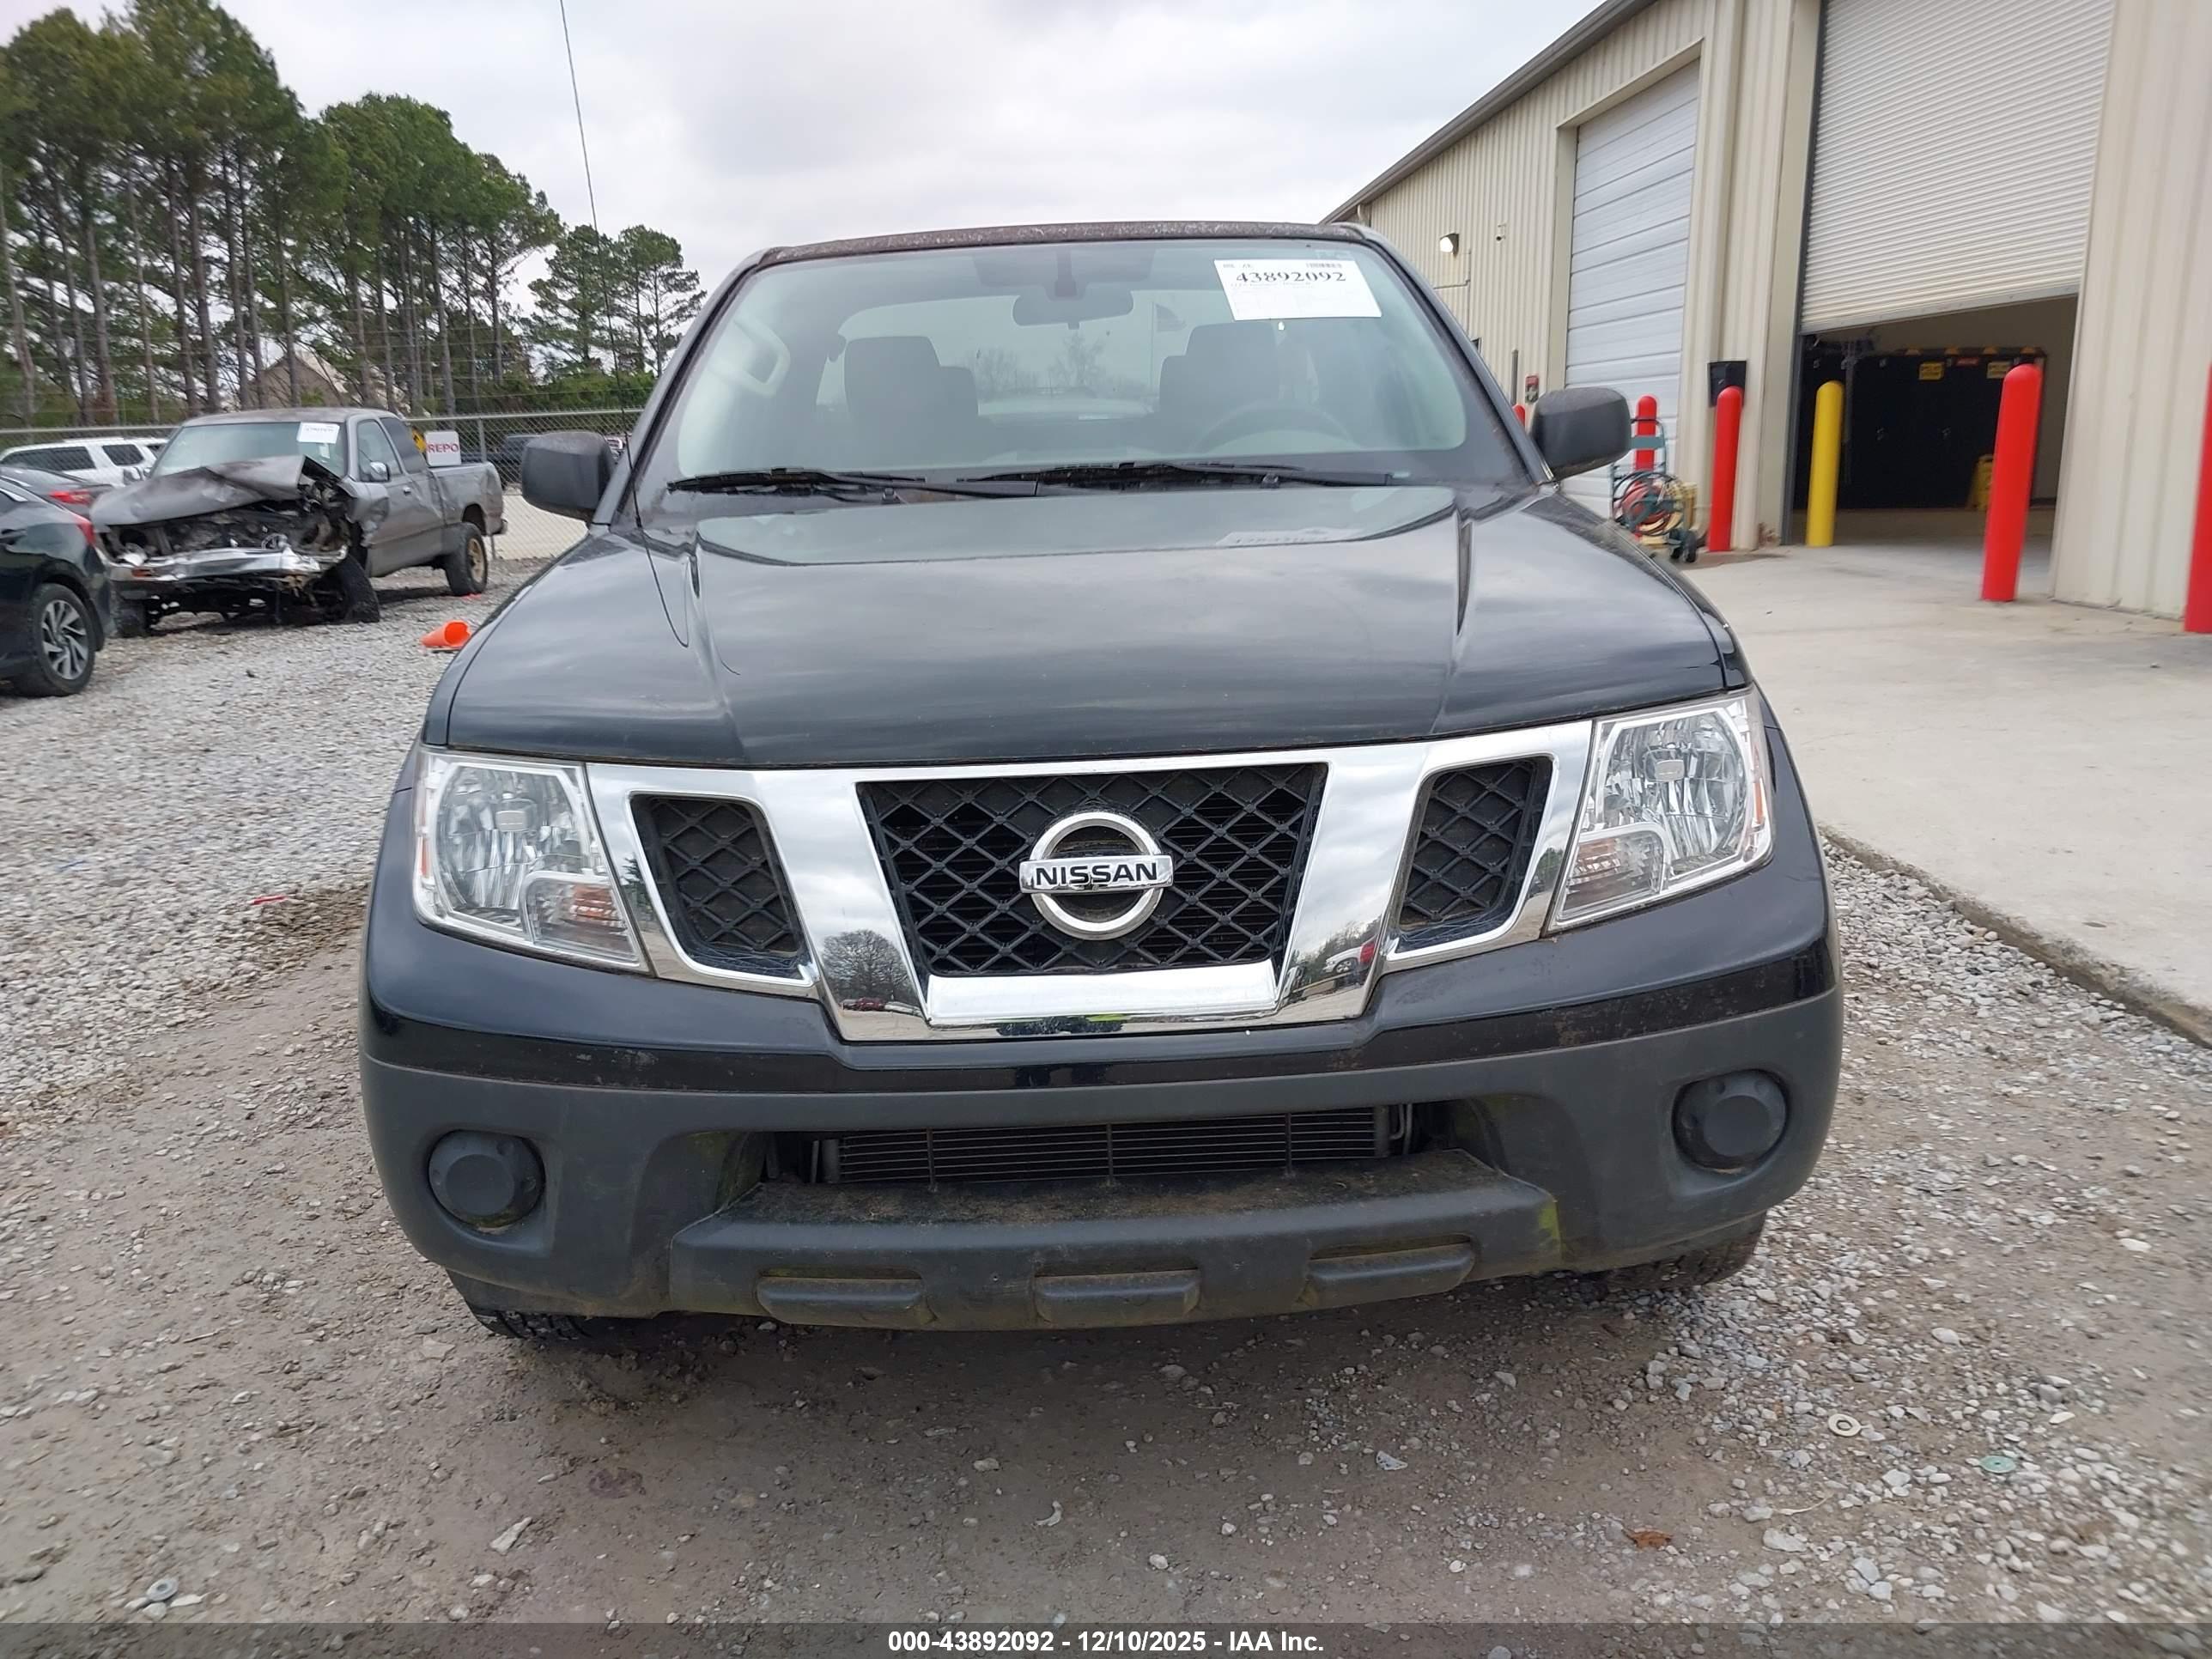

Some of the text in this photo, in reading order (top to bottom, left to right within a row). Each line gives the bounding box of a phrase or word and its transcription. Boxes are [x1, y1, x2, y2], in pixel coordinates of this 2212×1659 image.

[1237, 271, 1346, 283] 43892092
[428, 443, 459, 453] REPO
[1036, 862, 1158, 885] NISSAN
